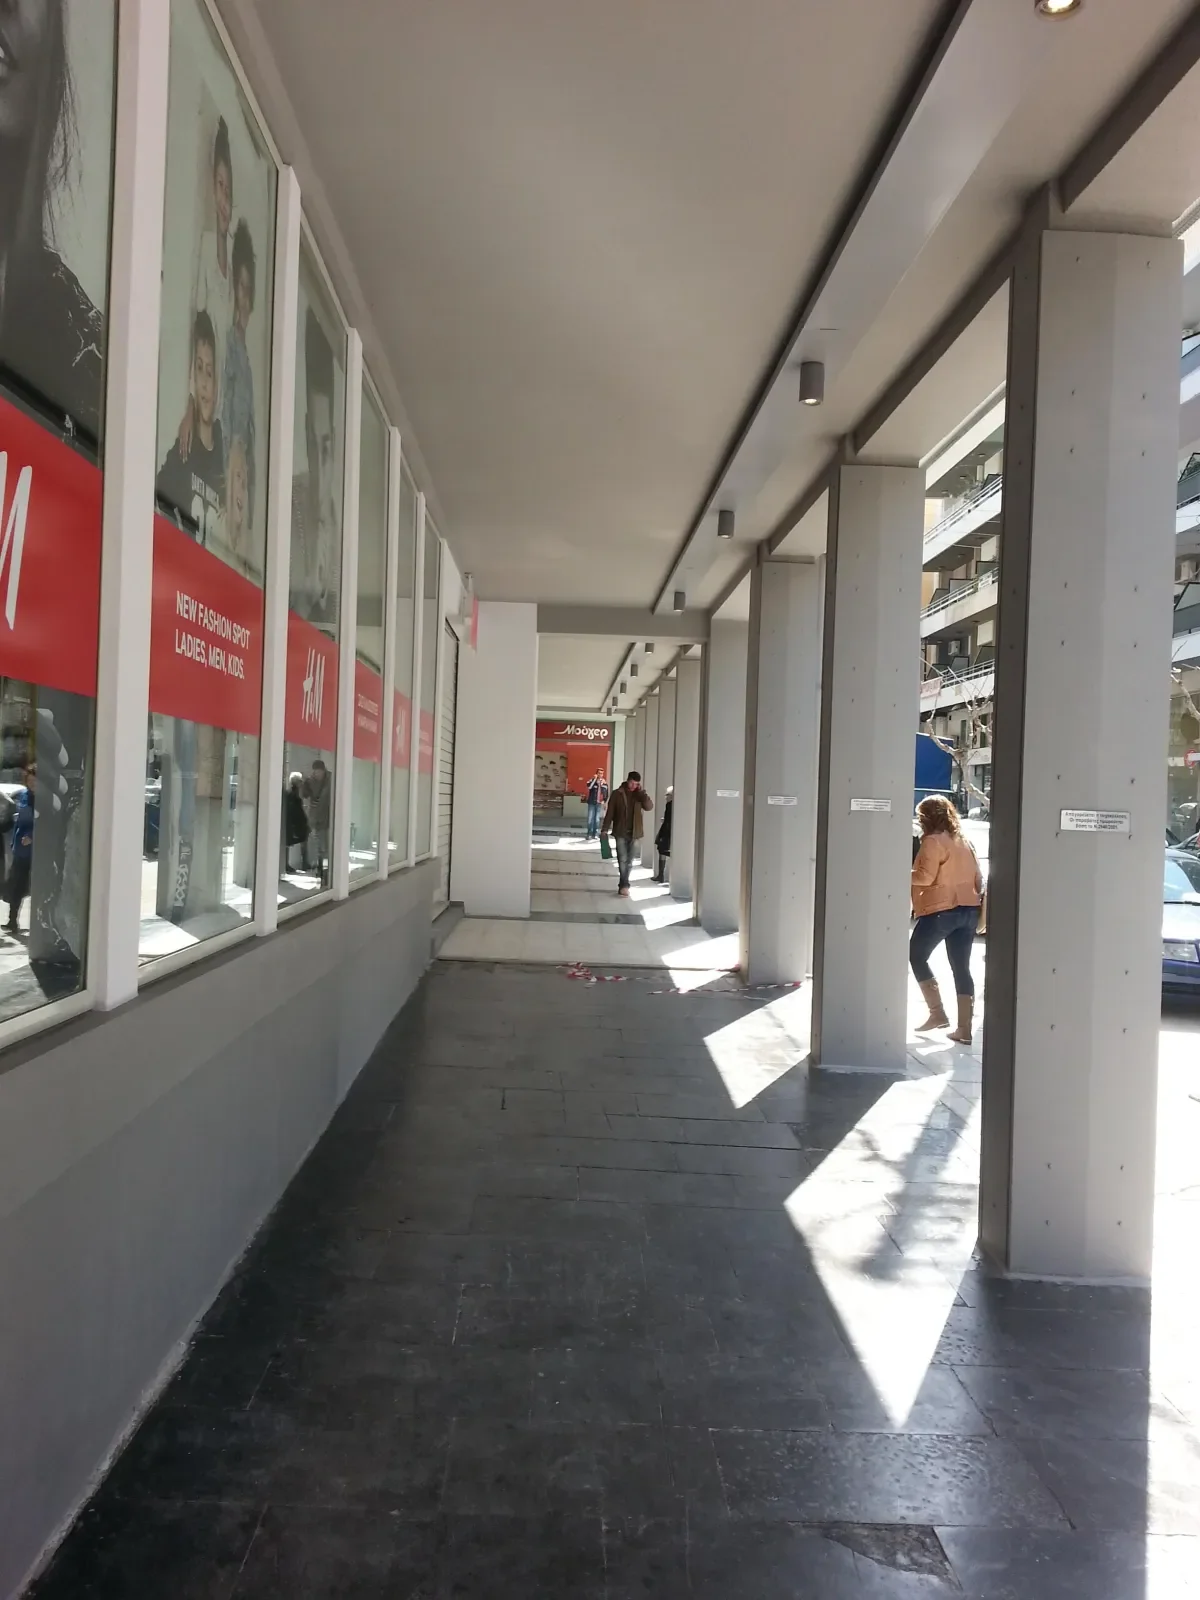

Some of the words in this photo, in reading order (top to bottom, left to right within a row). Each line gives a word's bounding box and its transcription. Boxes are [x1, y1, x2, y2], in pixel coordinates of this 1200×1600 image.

[176, 590, 197, 622] NEW
[198, 602, 232, 640] FASHION
[232, 622, 250, 650] SPOT
[175, 628, 207, 668] LADIES,
[209, 643, 227, 675] MEN,
[228, 653, 245, 680] KIDS.
[302, 646, 326, 728] H&M
[553, 724, 609, 740] Μούγερ
